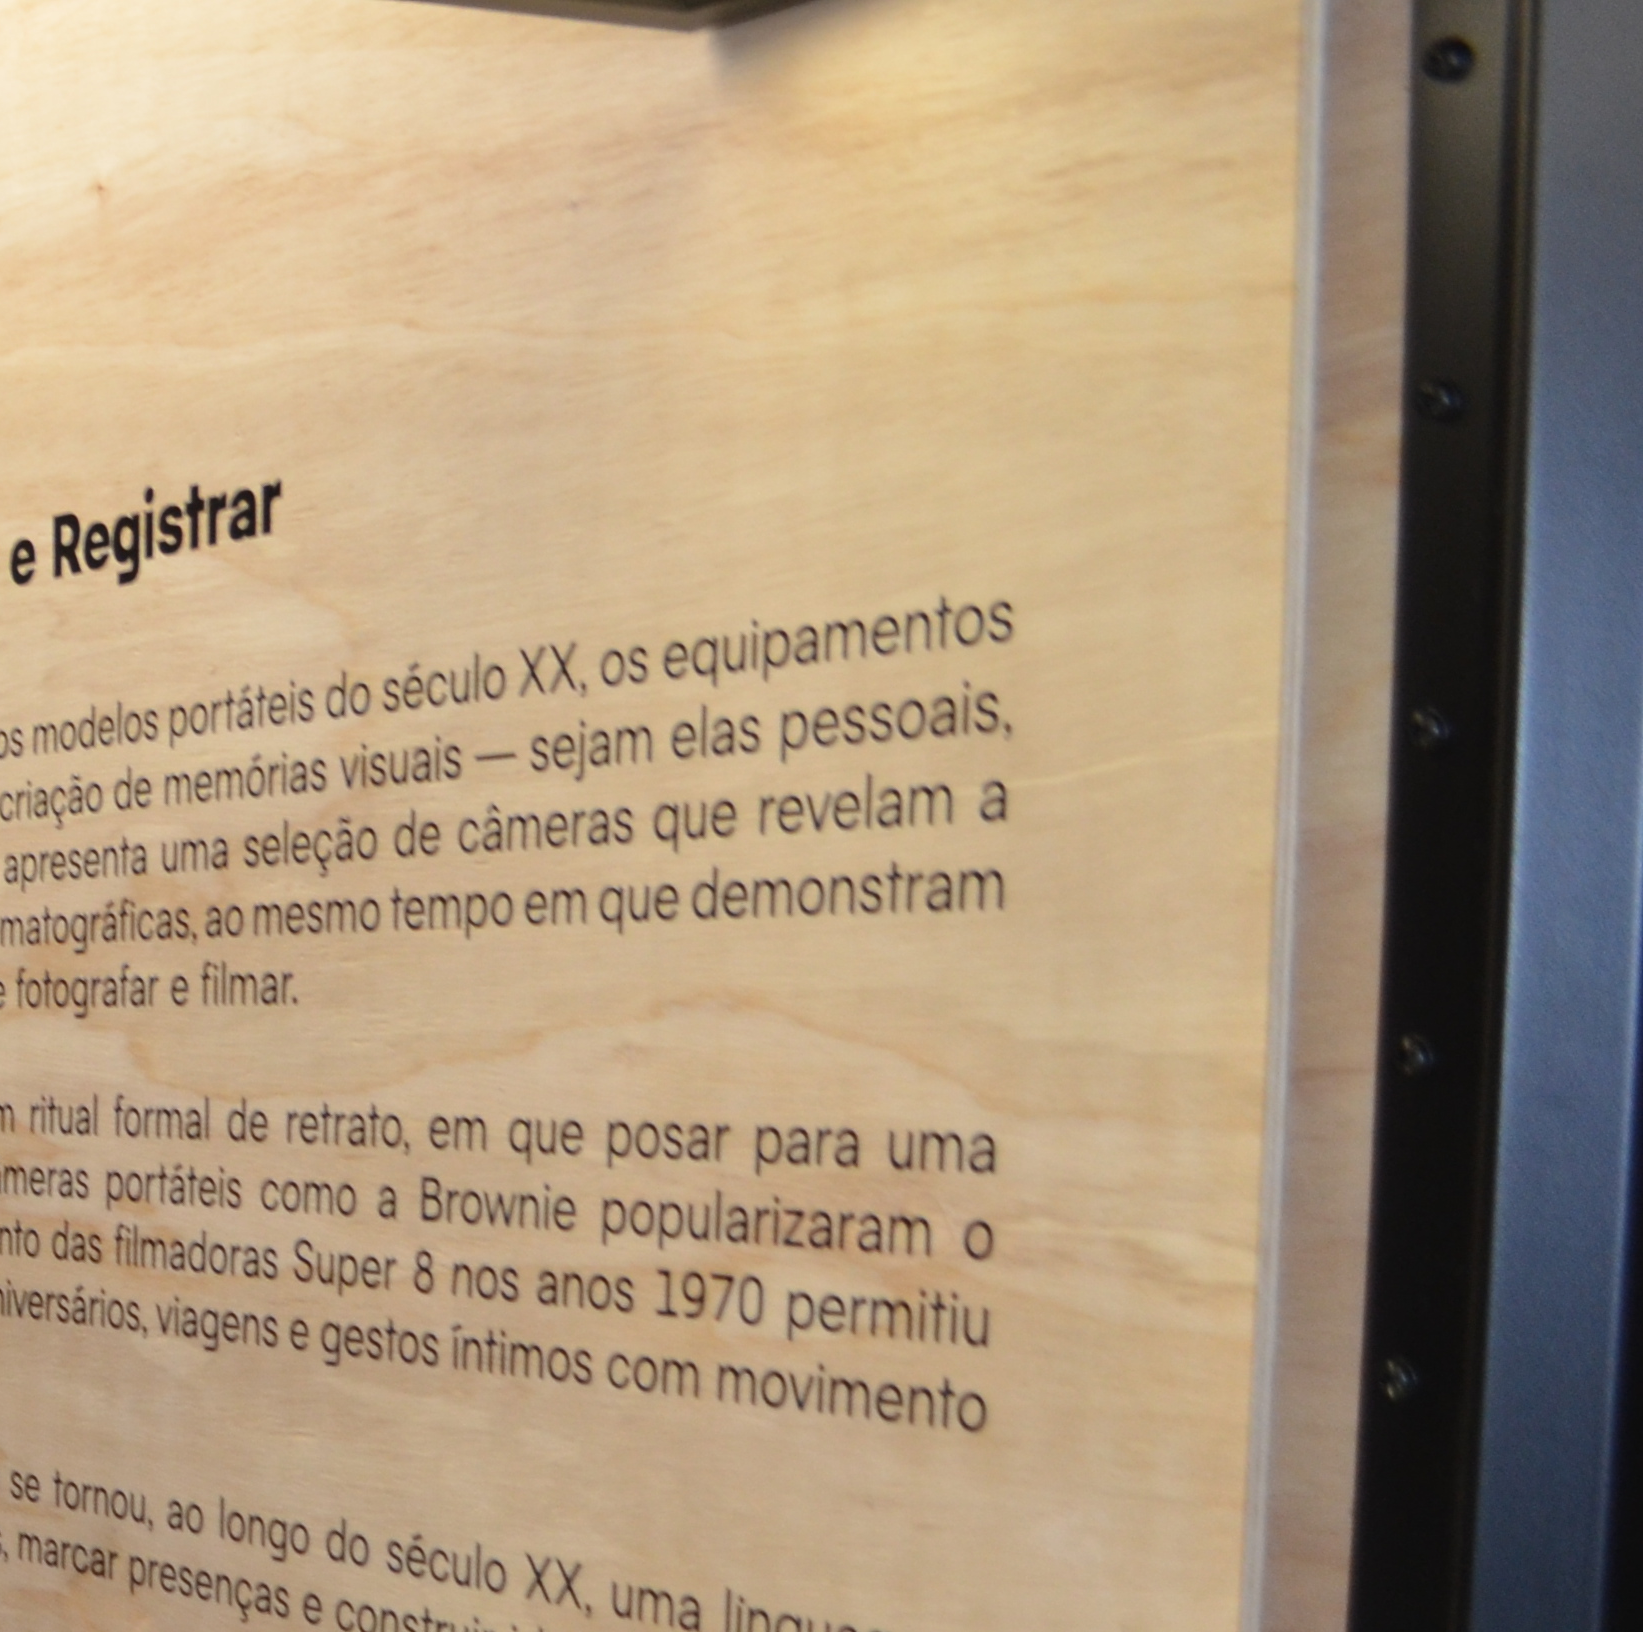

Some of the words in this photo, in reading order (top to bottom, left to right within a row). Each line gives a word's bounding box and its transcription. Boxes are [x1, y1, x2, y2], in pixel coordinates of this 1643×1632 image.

[10, 538, 35, 586] e
[53, 479, 282, 586] Registrar
[33, 701, 158, 754] modelos
[169, 680, 315, 749] portáteis
[326, 670, 371, 719] do
[383, 652, 506, 713] século
[519, 641, 587, 698] XX,
[600, 645, 648, 687] os
[663, 596, 1014, 687] equipamentos
[114, 766, 152, 811] de
[164, 752, 327, 806] memórias
[340, 735, 462, 789] visuais
[530, 719, 653, 782] sejam
[671, 704, 761, 760] elas
[780, 680, 1013, 764] pessoais,
[30, 1093, 98, 1136] ritual
[114, 1093, 210, 1140] formal
[227, 1097, 268, 1143] de
[287, 1103, 410, 1156] retrato,
[428, 1115, 487, 1152] em
[509, 1117, 584, 1165] que
[606, 1120, 732, 1169] posar
[754, 1125, 860, 1176] para
[888, 1130, 996, 1174] uma
[52, 1219, 102, 1264] das
[115, 1223, 278, 1280] filmadoras
[293, 1238, 397, 1296] Super
[413, 1248, 434, 1295] 8
[451, 1263, 519, 1303] nos
[537, 1269, 634, 1314] anos
[655, 1267, 764, 1327] 1970
[787, 1289, 991, 1348] permitiu
[10, 1470, 40, 1503] se
[53, 1470, 153, 1532] tornou,
[167, 1499, 204, 1535] ao
[220, 1496, 310, 1563] longo
[326, 1518, 370, 1568] do
[387, 1533, 507, 1595] século
[525, 1552, 593, 1619] XX,
[612, 1581, 701, 1632] uma
[18, 1532, 118, 1579] marcar
[129, 1556, 290, 1623] presenças
[302, 1592, 323, 1626] e
